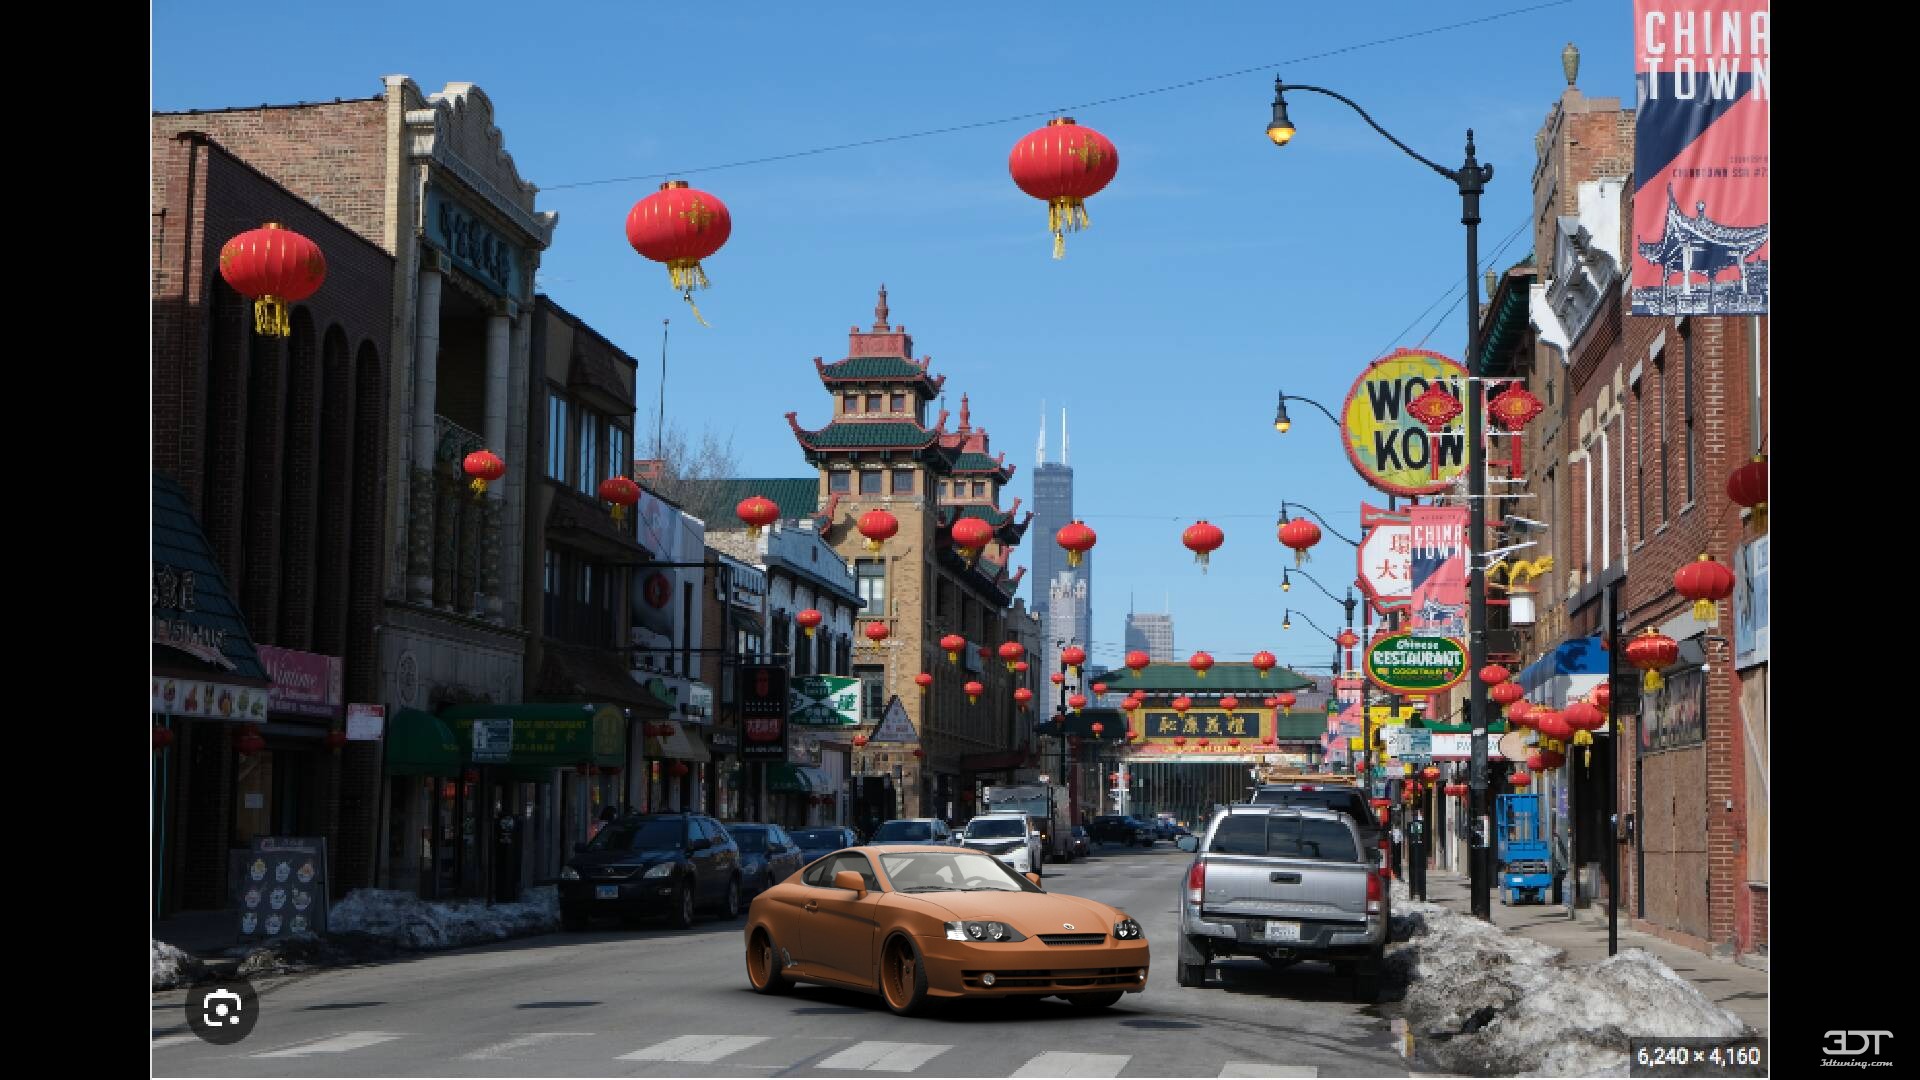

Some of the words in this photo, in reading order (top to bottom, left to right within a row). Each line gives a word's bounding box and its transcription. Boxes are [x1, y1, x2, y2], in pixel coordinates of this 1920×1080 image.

[1645, 11, 1767, 55] CHINA
[1643, 57, 1767, 100] TOWN
[1374, 426, 1463, 472] KOW
[1414, 524, 1462, 541] CHINA
[1414, 541, 1462, 560] TOWN
[1396, 639, 1439, 650] Chinese
[1373, 650, 1462, 667] RESTAURANT
